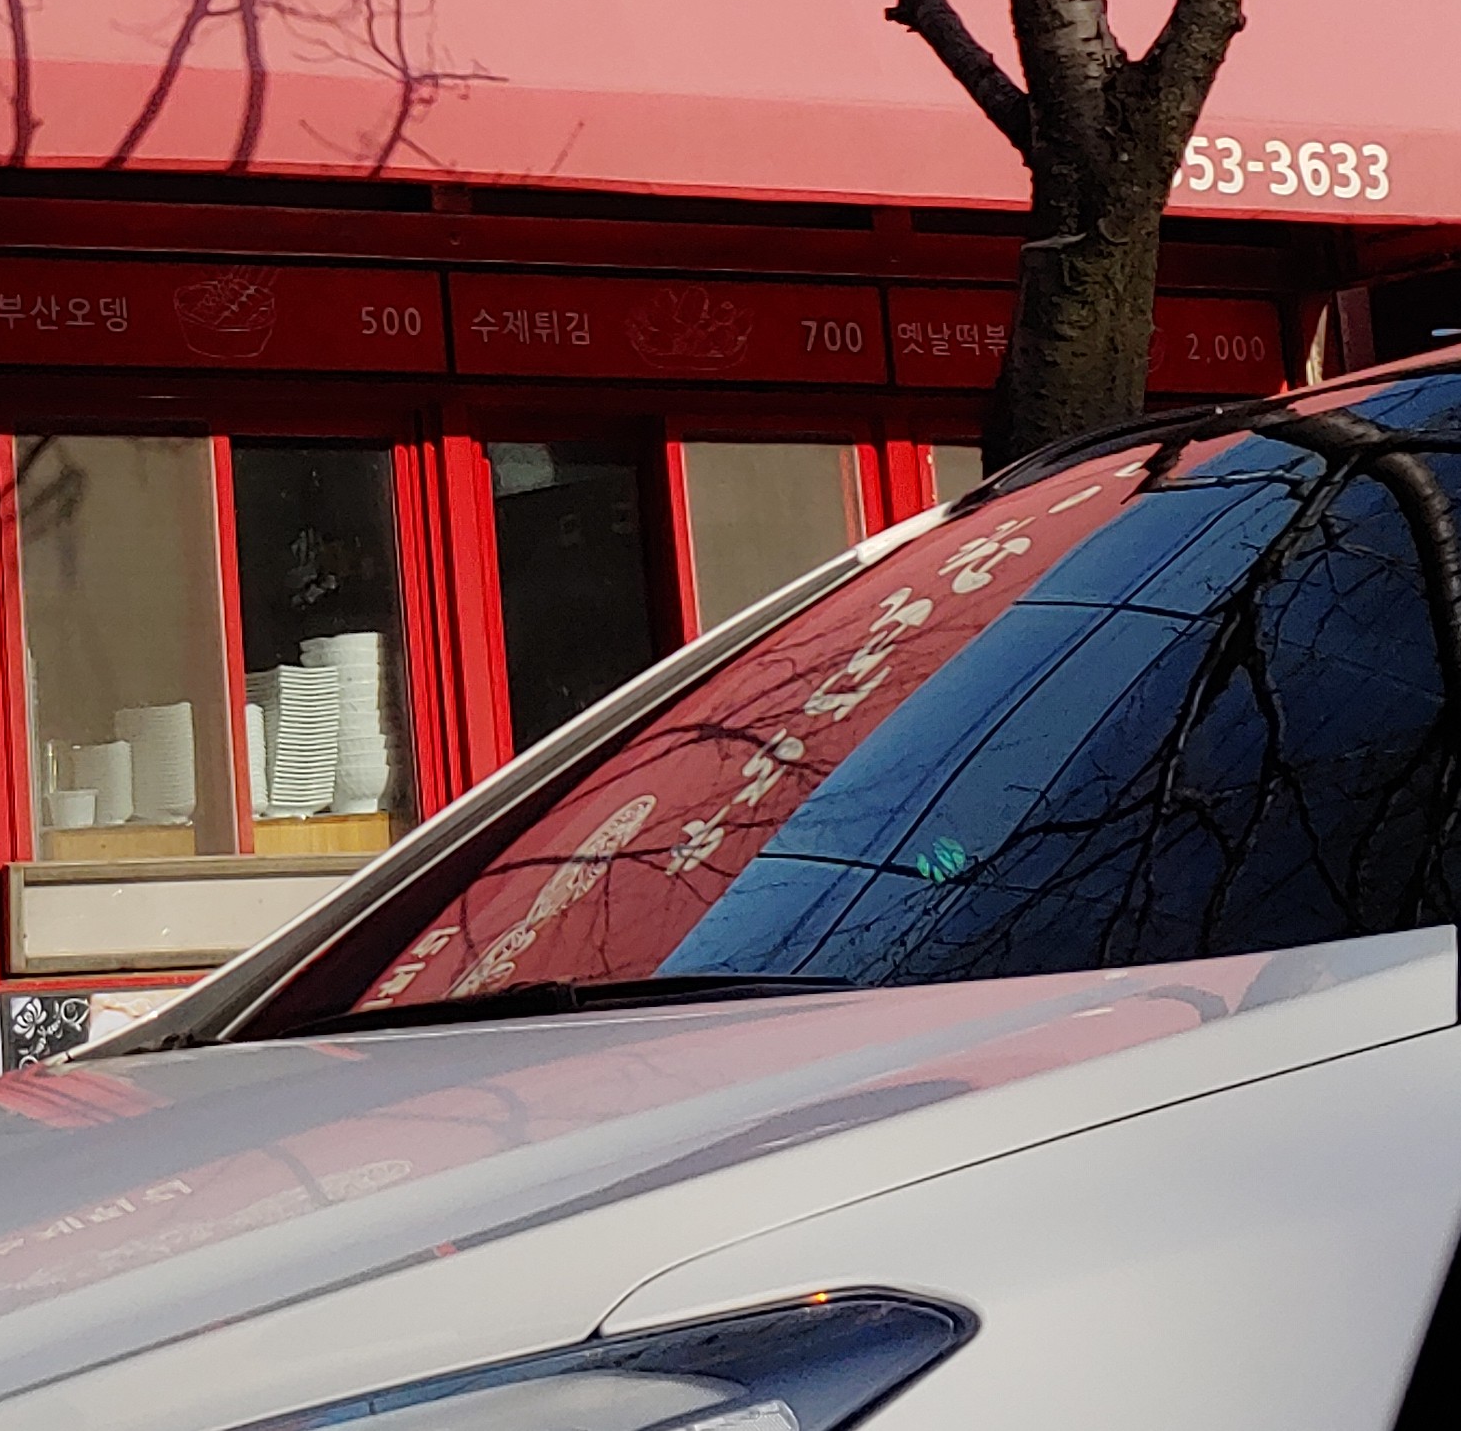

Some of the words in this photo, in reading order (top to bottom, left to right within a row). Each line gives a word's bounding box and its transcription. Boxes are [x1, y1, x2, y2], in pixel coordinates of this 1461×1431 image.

[1171, 134, 1390, 201] 53-3633
[360, 306, 423, 337] 500
[470, 308, 592, 347] 수제튀김
[800, 320, 864, 354] 700
[895, 320, 1010, 357] 옛날떡볶
[1184, 332, 1267, 365] 2,000
